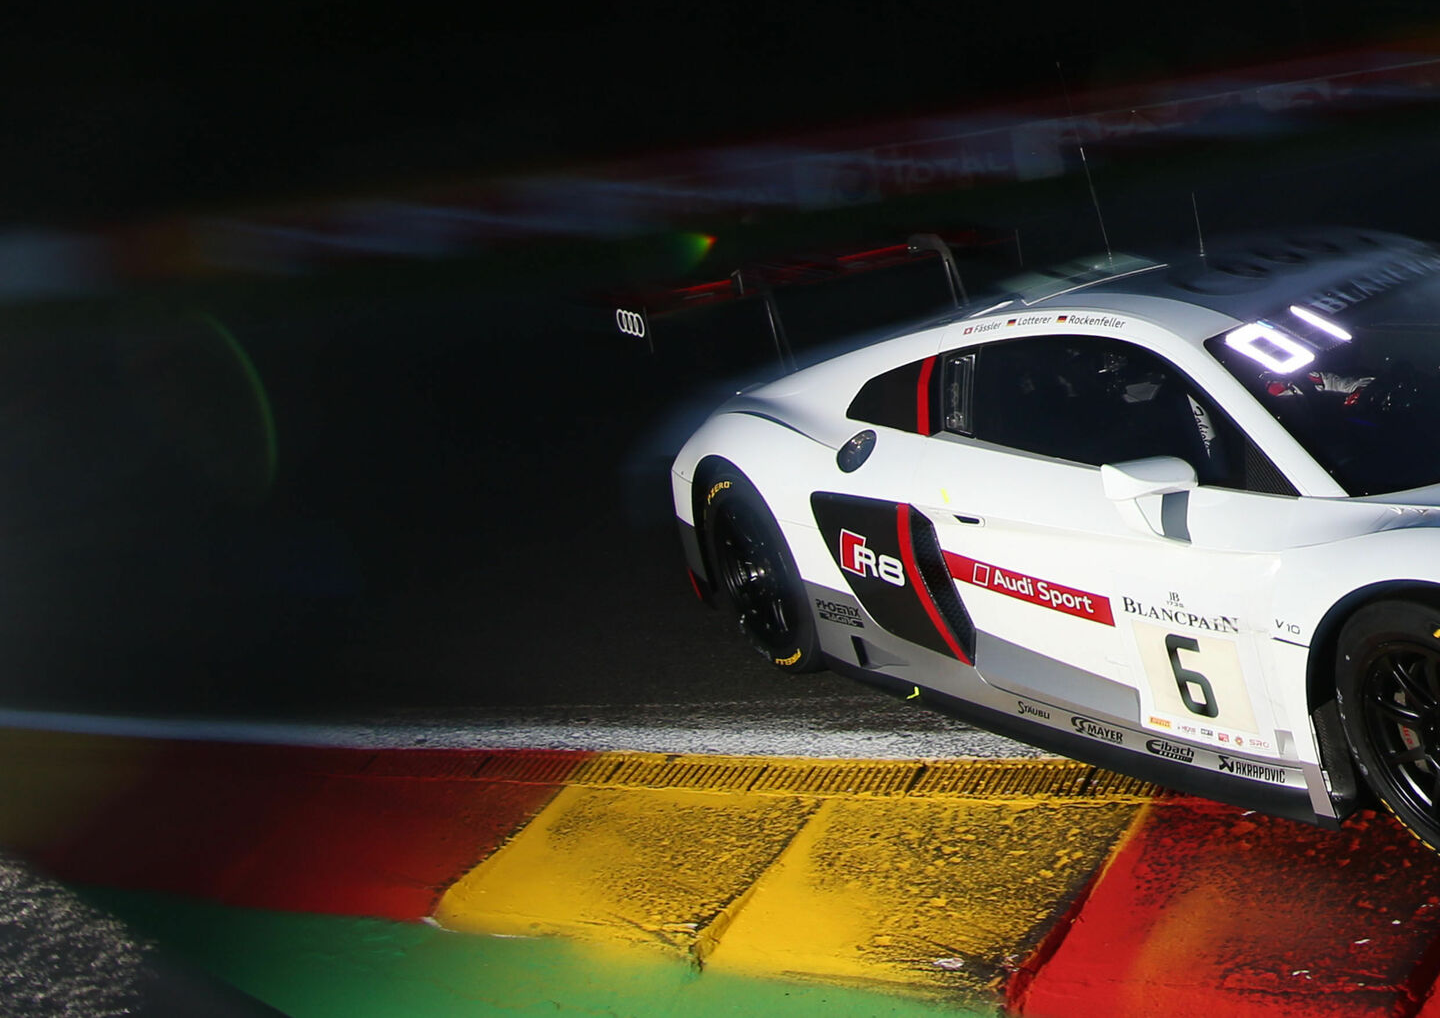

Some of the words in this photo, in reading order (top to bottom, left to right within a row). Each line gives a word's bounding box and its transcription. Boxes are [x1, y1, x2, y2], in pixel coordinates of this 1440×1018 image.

[973, 322, 1002, 334] Fässler
[1017, 316, 1052, 326] Lotterer
[1069, 315, 1126, 329] Rockenfeller
[852, 541, 905, 587] R8
[993, 570, 1035, 597] Audi
[1038, 582, 1094, 615] Sport
[1165, 633, 1219, 718] 6
[1087, 724, 1123, 742] MAYER
[1146, 739, 1195, 758] Eibach
